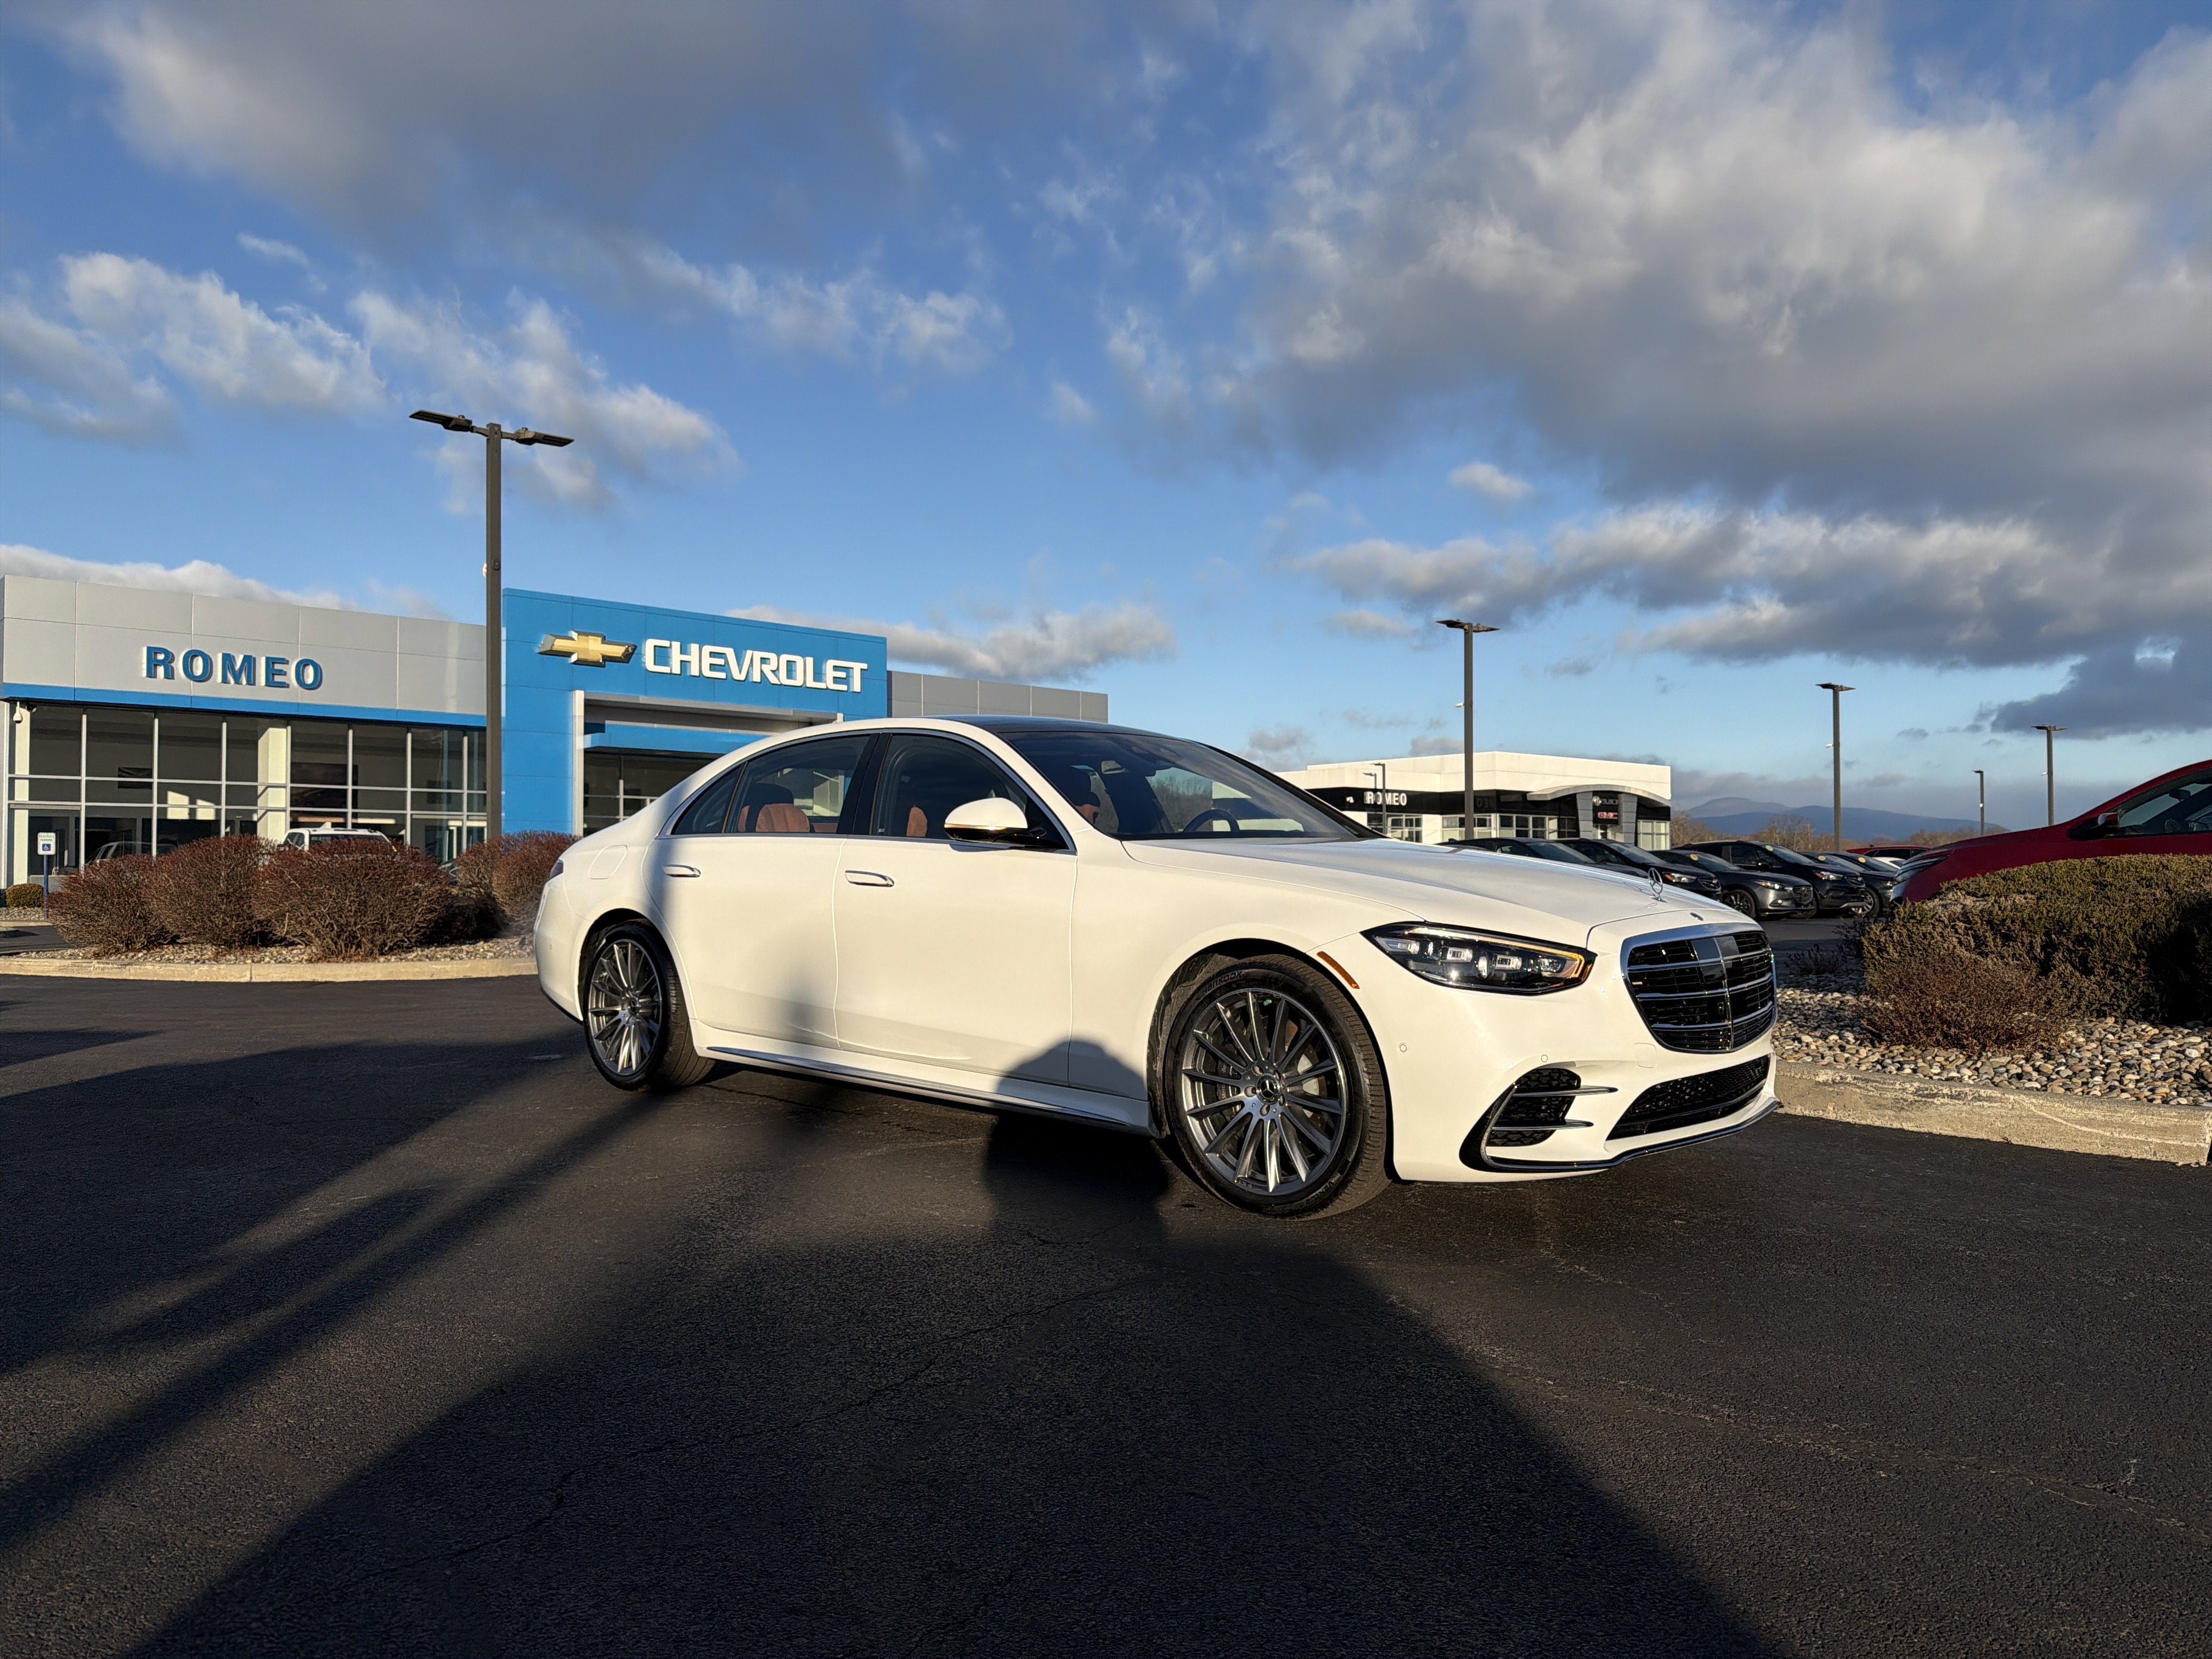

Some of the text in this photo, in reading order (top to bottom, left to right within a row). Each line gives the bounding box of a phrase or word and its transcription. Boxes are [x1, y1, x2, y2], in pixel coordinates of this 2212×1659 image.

[140, 646, 323, 690] ROMEO
[645, 639, 868, 693] CHEVROLET
[1364, 791, 1407, 806] ROMEO
[1597, 811, 1618, 820] GMC
